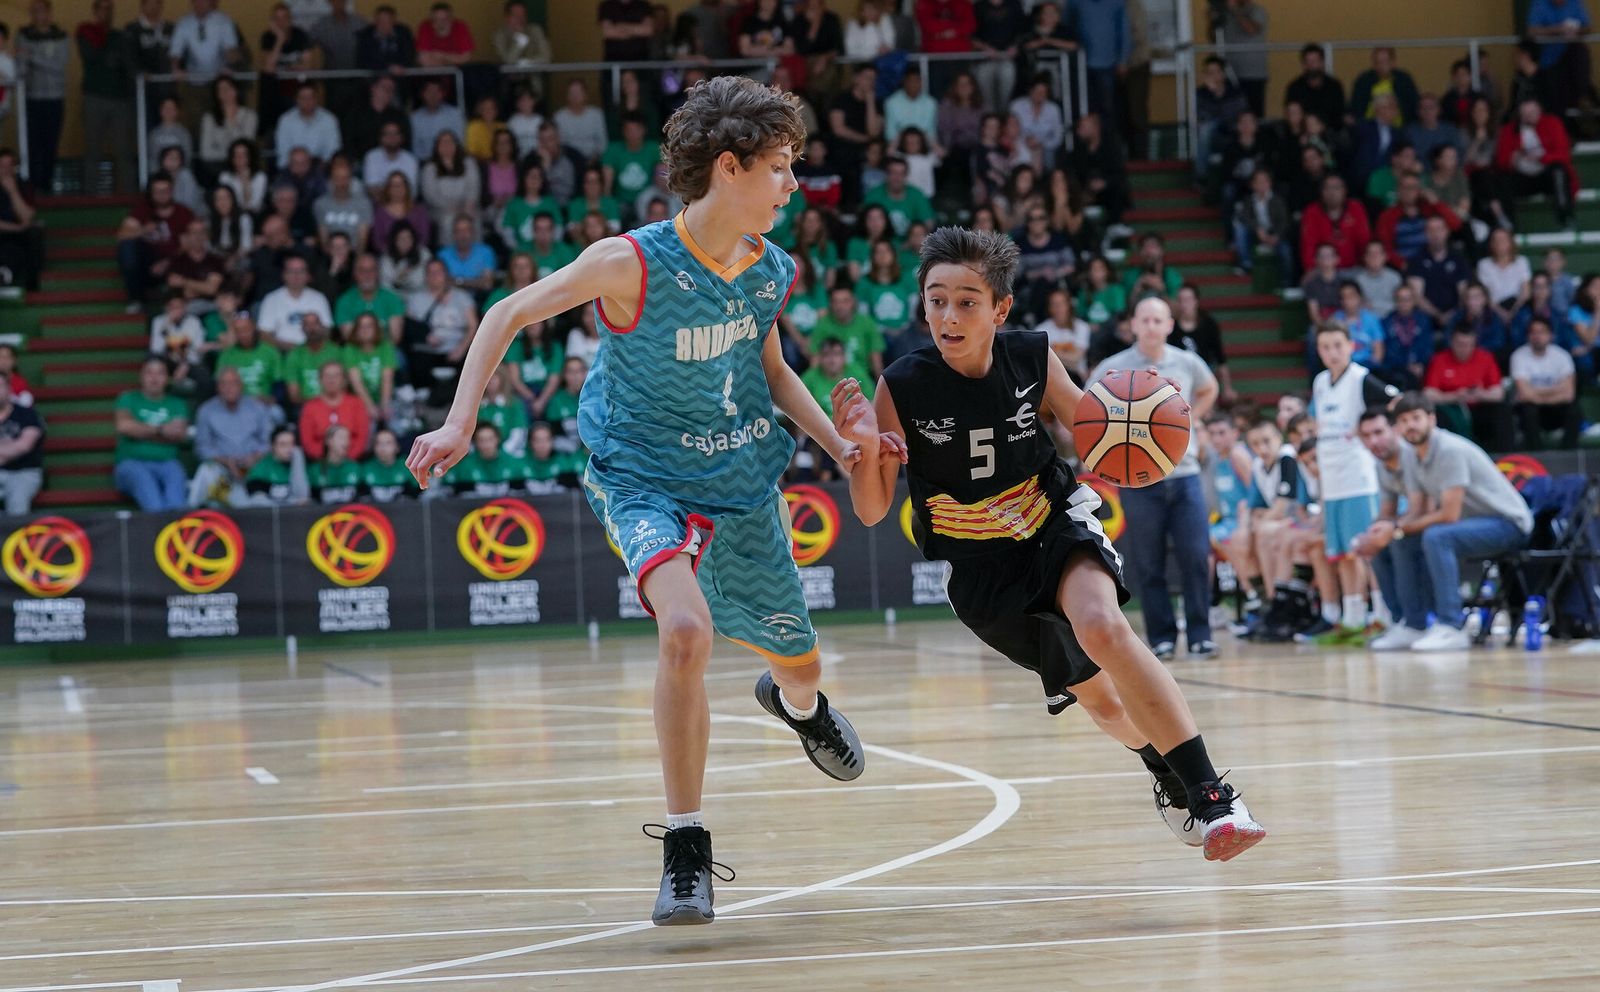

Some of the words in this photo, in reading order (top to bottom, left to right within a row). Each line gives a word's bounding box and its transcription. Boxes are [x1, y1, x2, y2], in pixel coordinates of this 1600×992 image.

[1109, 406, 1125, 416] FAB
[911, 417, 956, 430] FAB
[1131, 428, 1148, 438] FAB
[969, 427, 995, 481] 5
